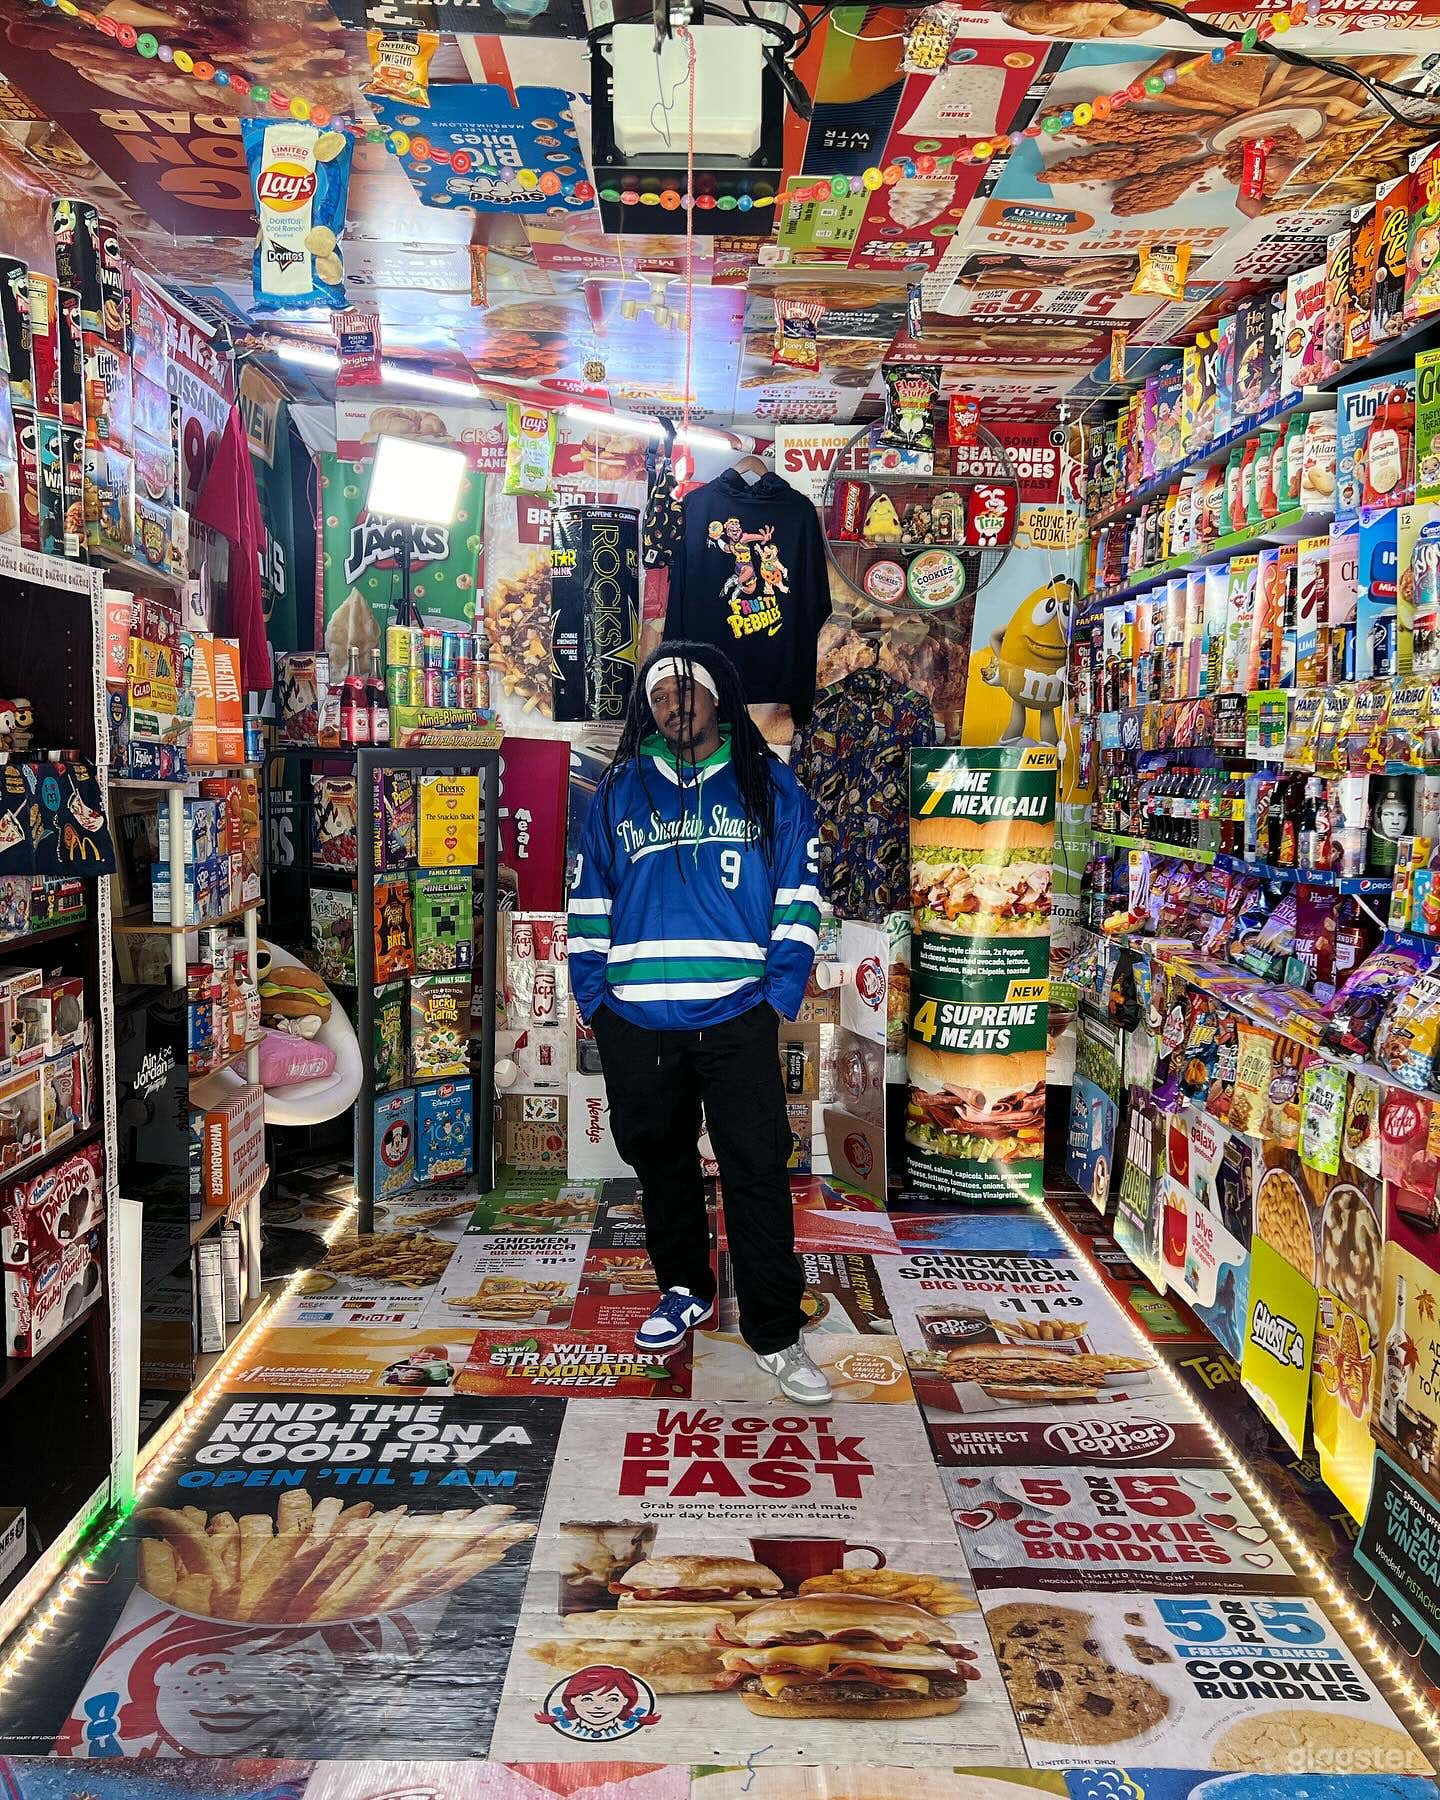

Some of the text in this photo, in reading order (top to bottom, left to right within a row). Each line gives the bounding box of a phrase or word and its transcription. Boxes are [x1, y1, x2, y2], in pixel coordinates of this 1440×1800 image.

[449, 134, 517, 148] bites
[824, 129, 869, 140] WTR
[272, 147, 308, 156] LIMITED
[823, 139, 868, 149] LIFE
[260, 173, 314, 202] Lay's
[469, 192, 546, 203] Stuffed
[1012, 208, 1068, 222] Ranch
[987, 231, 1069, 251] Strip
[1105, 227, 1229, 239] Basket
[268, 250, 304, 262] Doritos
[1080, 291, 1124, 316] 5
[98, 354, 118, 379] Little
[341, 354, 376, 365] Original
[890, 354, 1031, 363] CROISSANT
[1039, 354, 1095, 364] FREE
[895, 378, 935, 395] Fluffy
[784, 438, 817, 447] MAKE
[1004, 437, 1039, 446] SOME
[957, 447, 1056, 462] SEASONED
[956, 462, 1054, 478] POTATOES
[978, 518, 1003, 530] Trix
[1029, 515, 1078, 530] CRUNCHY
[1033, 529, 1070, 543] COOKIE
[345, 524, 450, 584] JACKS
[916, 566, 954, 585] COOKIES
[214, 653, 240, 702] WHEATIES
[1393, 688, 1424, 704] HARIBO
[418, 710, 478, 728] Mind-Blowing
[1391, 708, 1420, 716] Goldbears
[420, 736, 438, 745] NEW
[439, 736, 470, 748] FLAVOR
[1026, 754, 1056, 764] NEW
[436, 783, 465, 794] Cheerios
[952, 772, 991, 792] THE
[951, 795, 1048, 816] MEXICALI
[616, 820, 645, 852] The
[720, 850, 742, 890] 9
[422, 883, 468, 893] MINECRAFT
[1002, 948, 1024, 956] Pepper
[1012, 987, 1044, 997] NEW
[429, 998, 456, 1011] Lucky
[424, 1009, 458, 1023] Charms
[914, 1001, 938, 1042] 4
[940, 1004, 1038, 1026] SUPREME
[940, 1028, 1011, 1050] MEATS
[141, 1053, 157, 1073] Air
[134, 1060, 168, 1089] Jordan
[1191, 1126, 1217, 1157] galaxy
[210, 1123, 223, 1196] WHATABURGER
[1195, 1211, 1213, 1242] Dive
[802, 1254, 821, 1285] CARDS
[817, 1254, 834, 1275] GIFT
[911, 1256, 1054, 1270] CHICKEN
[898, 1267, 1080, 1282] SANDWICH
[920, 1280, 1072, 1294] BIG BOX MEAL
[552, 1344, 607, 1354] WILD
[489, 1353, 670, 1365] STRAWBERRY
[506, 1364, 648, 1377] LEMONADE
[531, 1376, 619, 1386] FREEZE
[223, 1403, 444, 1422] END THE
[656, 1408, 833, 1435] We GOT
[1079, 1419, 1128, 1436] Dr
[208, 1423, 533, 1445] NIGHT ON A
[947, 1432, 1030, 1443] PERFECT
[1064, 1423, 1164, 1455] Pepper
[195, 1443, 492, 1464] GOOD FRY
[623, 1432, 871, 1461] BREAK
[951, 1443, 1004, 1455] WITH
[176, 1469, 519, 1488] OPEN 'TIL 1 AM
[618, 1459, 874, 1499] FAST
[640, 1502, 674, 1510] Grab
[791, 1502, 816, 1510] and
[821, 1503, 857, 1511] make
[643, 1512, 676, 1520] your
[679, 1511, 704, 1520] day
[756, 1511, 767, 1519] it
[808, 1512, 855, 1520] starts.
[1014, 1519, 1216, 1542] COOKIE
[1022, 1541, 1232, 1564] BUNDLES
[1376, 1542, 1404, 1579] Wonderful
[1081, 1572, 1130, 1580] LIMITED
[1165, 1574, 1195, 1582] ONLY
[1154, 1599, 1227, 1643] 5
[1223, 1600, 1266, 1643] FOR
[1188, 1647, 1330, 1659] FRESHLY BAKED
[1185, 1660, 1361, 1683] COOKIE
[1192, 1682, 1372, 1703] BUNDLES
